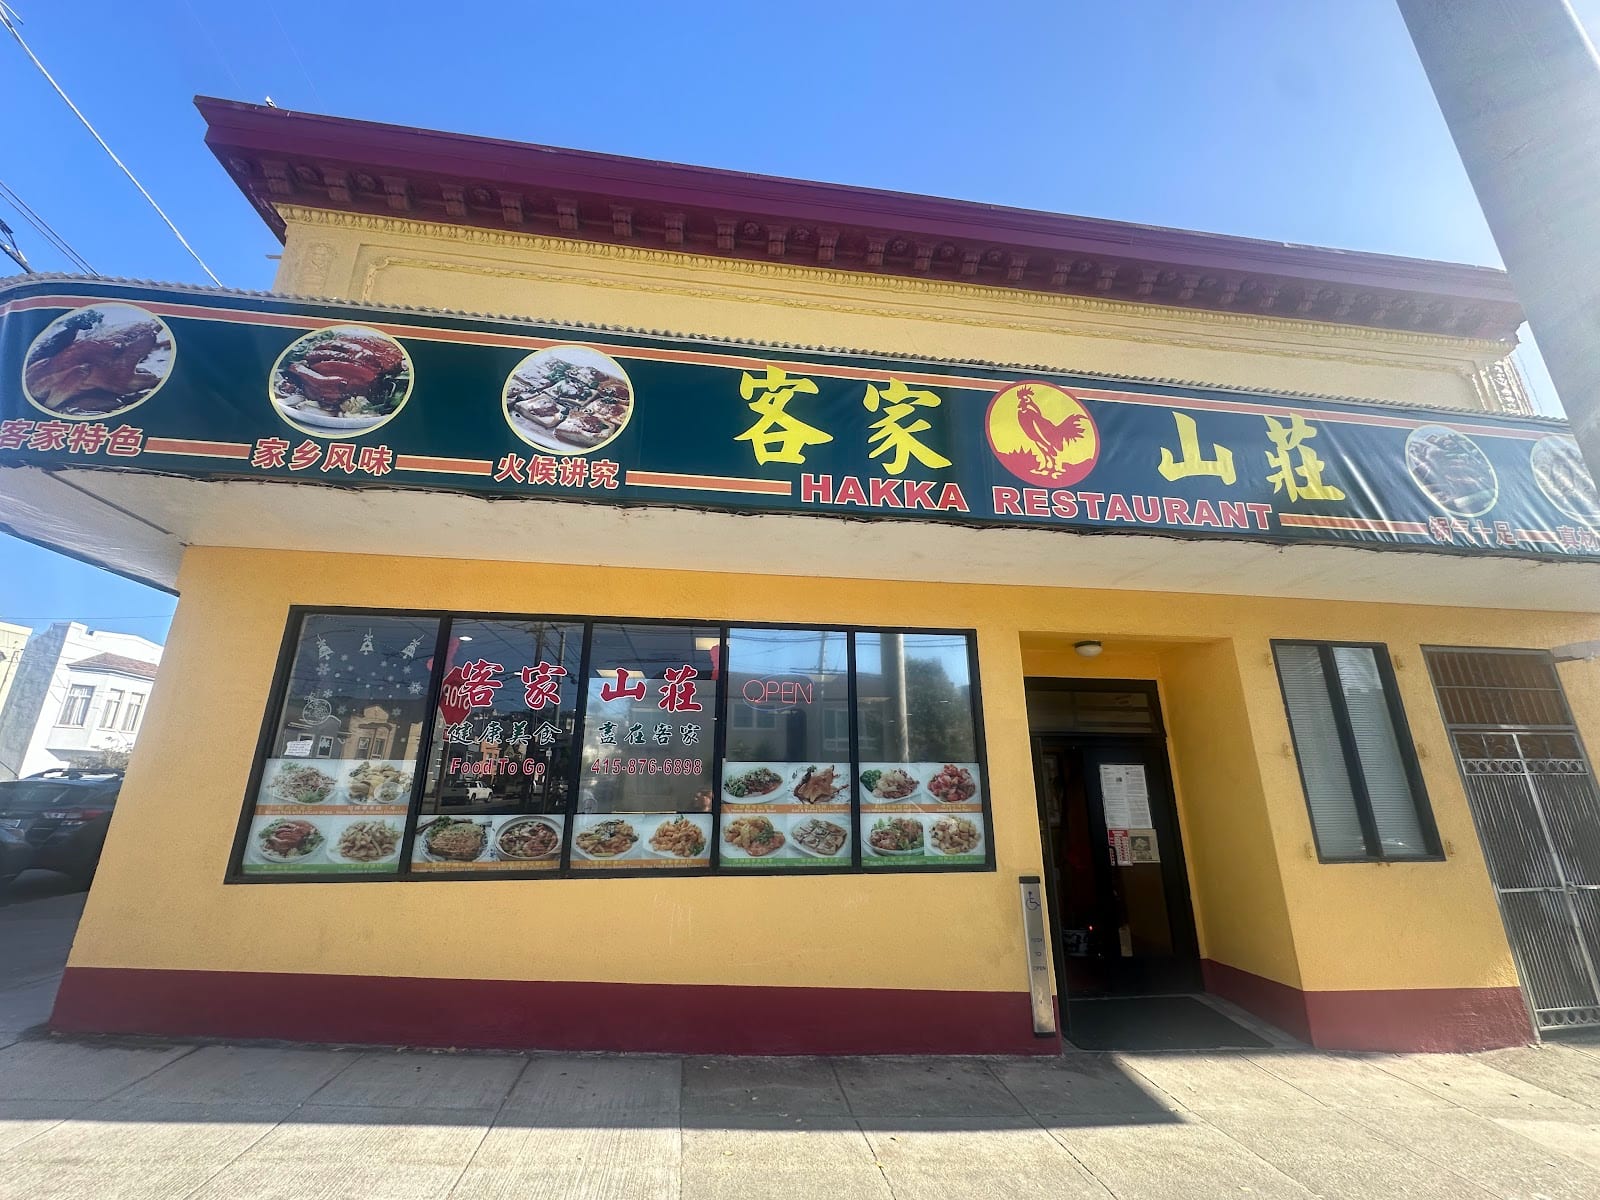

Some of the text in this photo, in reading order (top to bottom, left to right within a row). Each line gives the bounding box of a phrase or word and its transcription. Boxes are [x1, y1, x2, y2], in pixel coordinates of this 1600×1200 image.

[0, 418, 143, 457] 客家特色
[732, 364, 953, 475] 客家
[251, 437, 393, 476] 家乡风味
[494, 453, 619, 489] 火候讲究
[801, 473, 1272, 530] HAKKA RESTAURANT
[458, 659, 567, 710] 客家
[743, 679, 812, 704] OPEN
[447, 721, 562, 745] 健康美食
[450, 757, 546, 775] Food To Go
[591, 758, 703, 775] 415-876-6898
